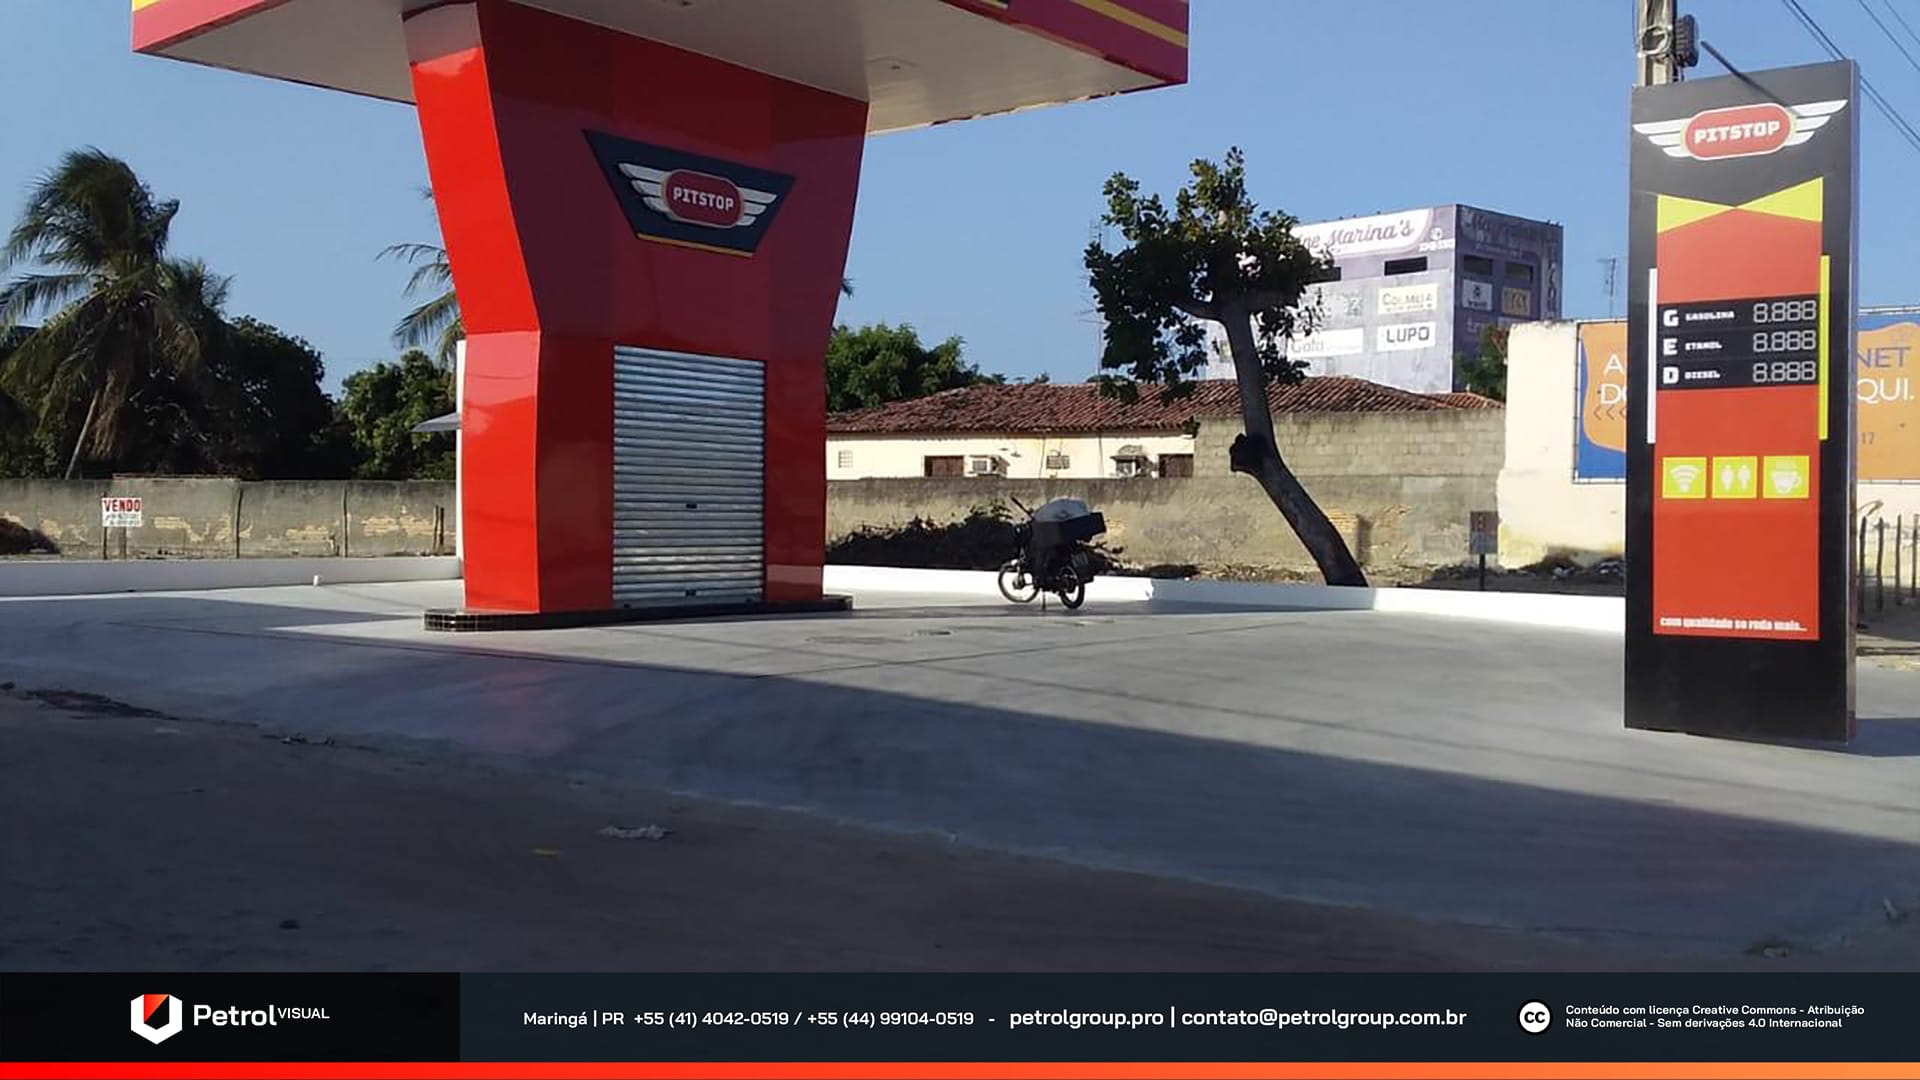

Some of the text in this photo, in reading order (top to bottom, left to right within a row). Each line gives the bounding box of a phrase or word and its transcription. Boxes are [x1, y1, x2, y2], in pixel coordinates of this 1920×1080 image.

[1694, 120, 1781, 145] PITSTOP
[673, 186, 734, 212] PITSTOP
[1324, 220, 1414, 247] Marina's
[1663, 309, 1679, 327] G
[1386, 326, 1430, 343] LUPO
[1663, 338, 1678, 355] E
[1663, 366, 1679, 384] D
[104, 499, 141, 512] VENDO
